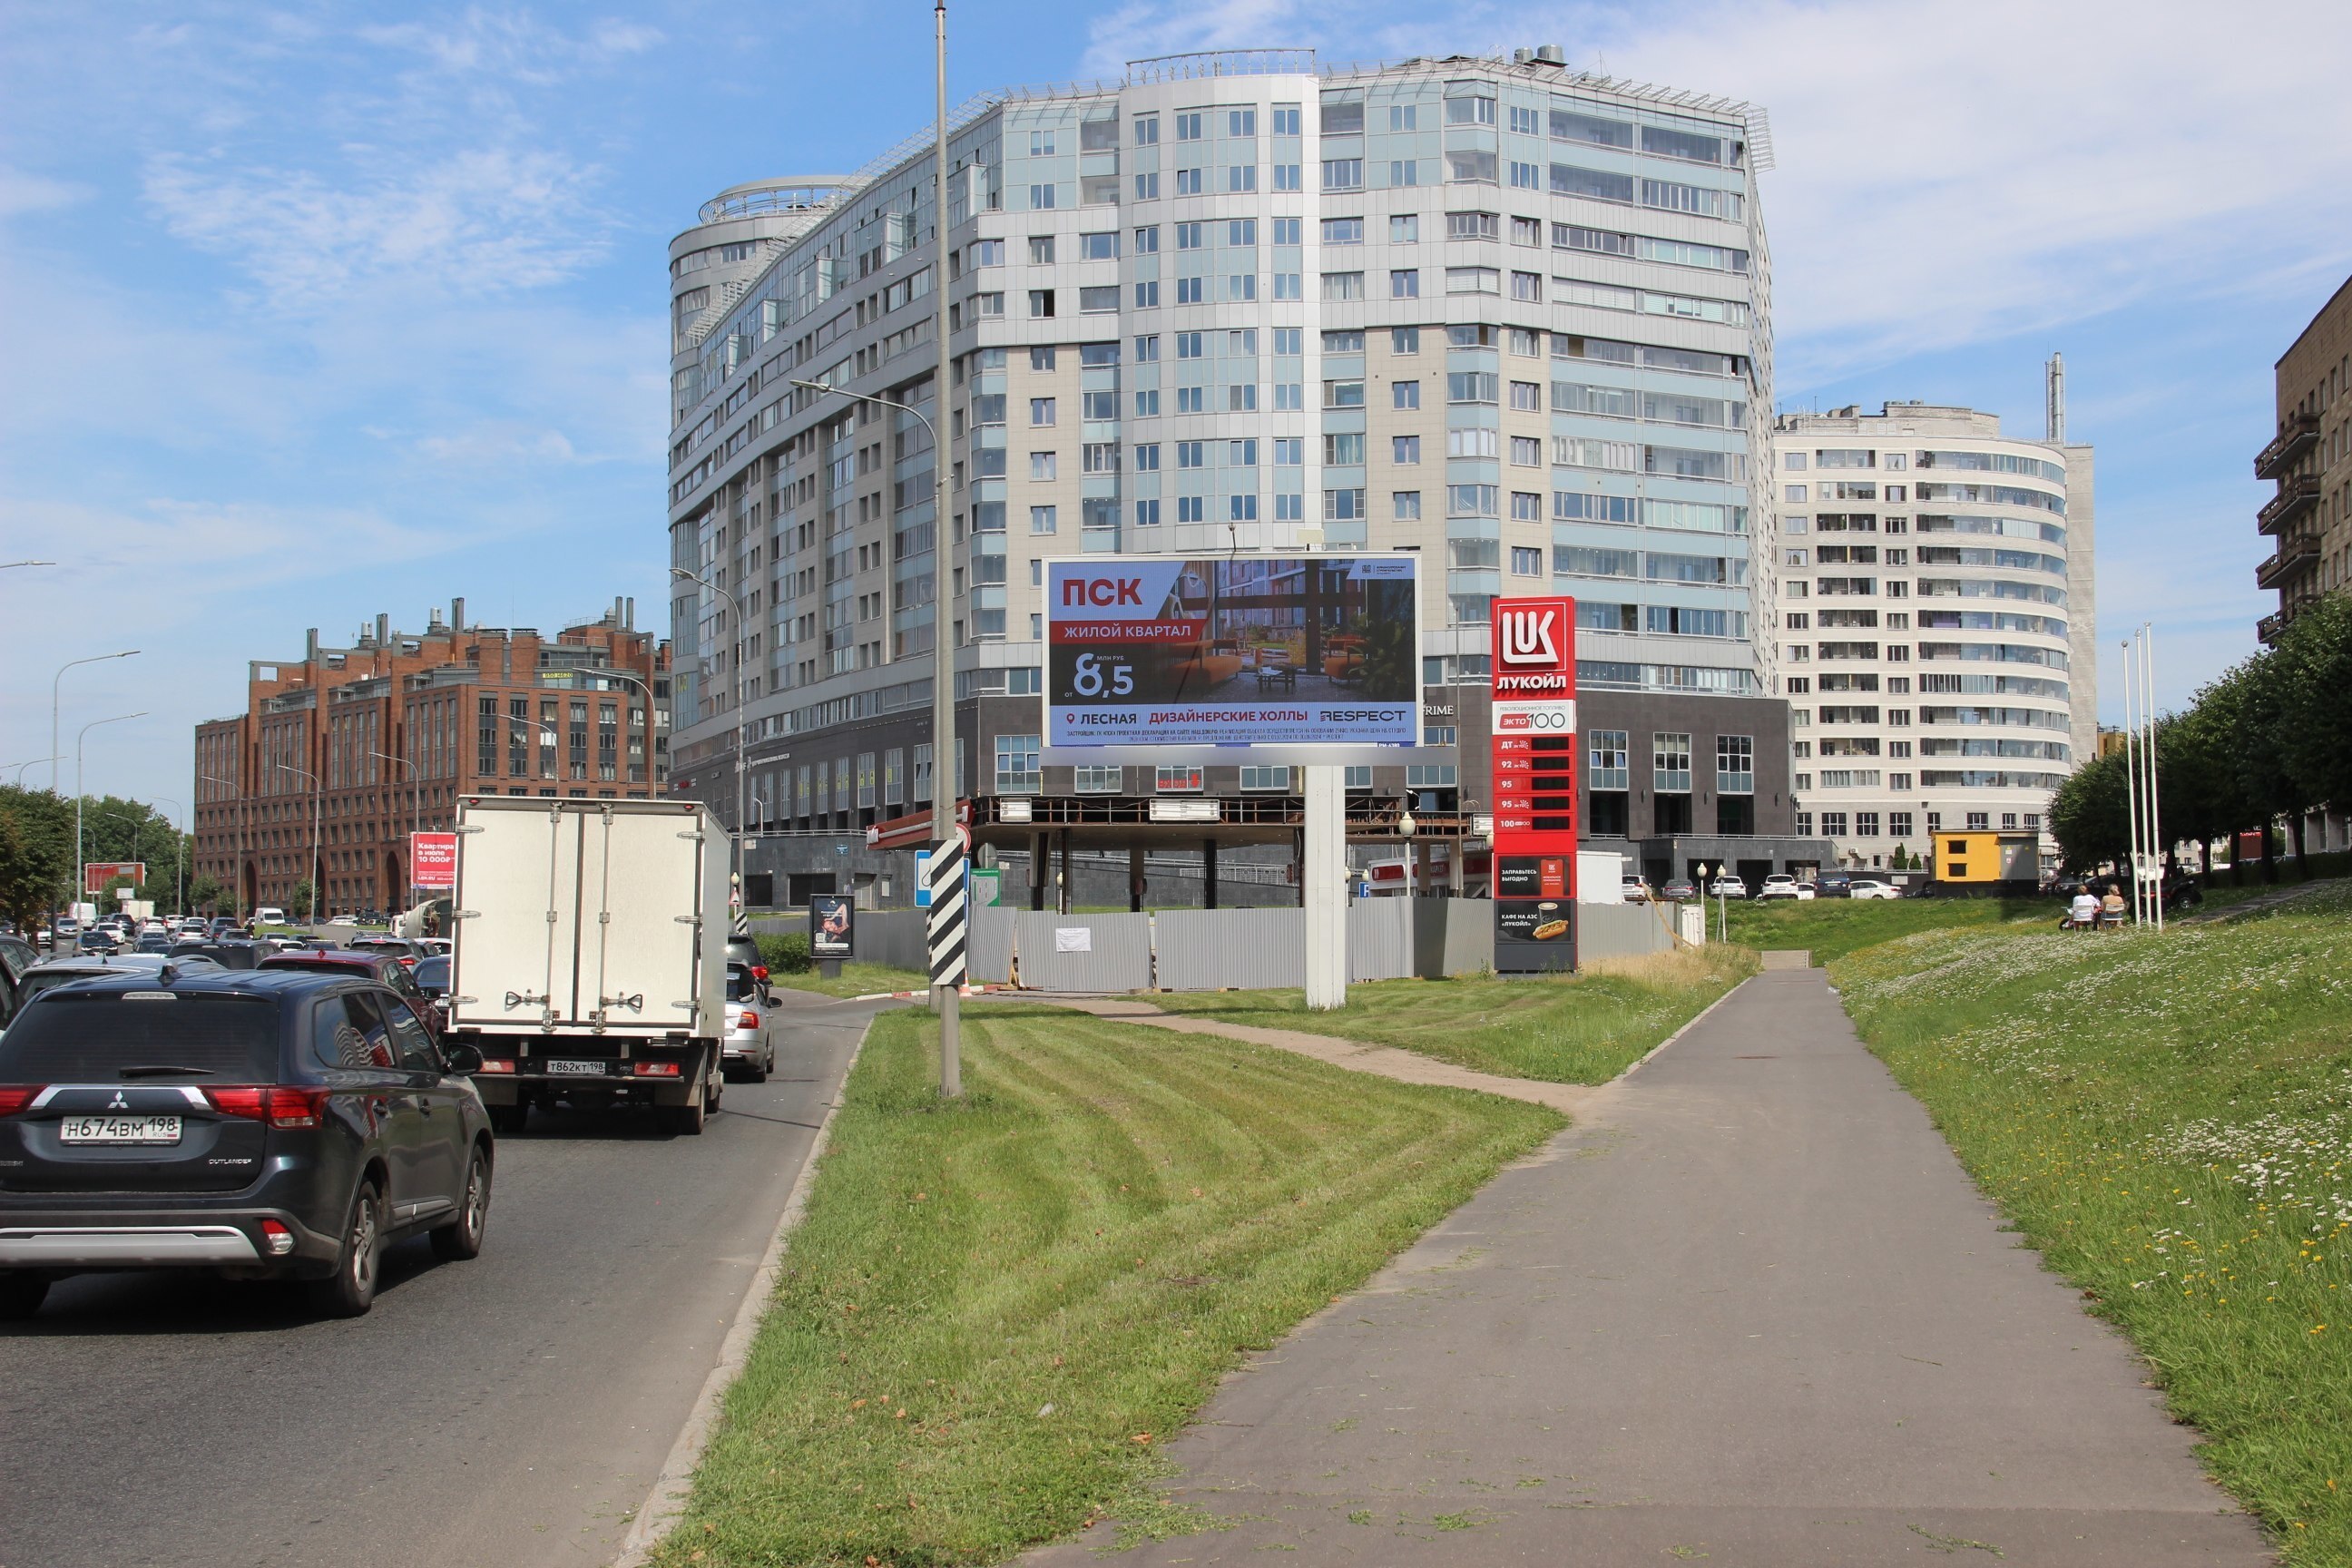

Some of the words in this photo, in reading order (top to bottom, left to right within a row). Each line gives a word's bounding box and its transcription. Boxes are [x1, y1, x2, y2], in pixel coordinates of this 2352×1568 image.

[1063, 578, 1142, 606] ПСК
[1064, 622, 1121, 638] ЖИЛОЙ
[1125, 625, 1191, 637] КВАРТАЛ
[1073, 652, 1133, 698] 8,5
[1497, 673, 1567, 690] ЛУКОЙЛ
[1149, 710, 1256, 725] ДИЗАЙНЕРСКИЕ
[1259, 711, 1308, 721] ХОЛЛЫ
[1320, 710, 1406, 721] RESPECT
[1423, 705, 1454, 715] RIME
[1080, 713, 1137, 725] ЛЕСНАЯ
[1527, 713, 1565, 728] 100
[1501, 741, 1513, 749] ДТ
[147, 1118, 175, 1131] 198
